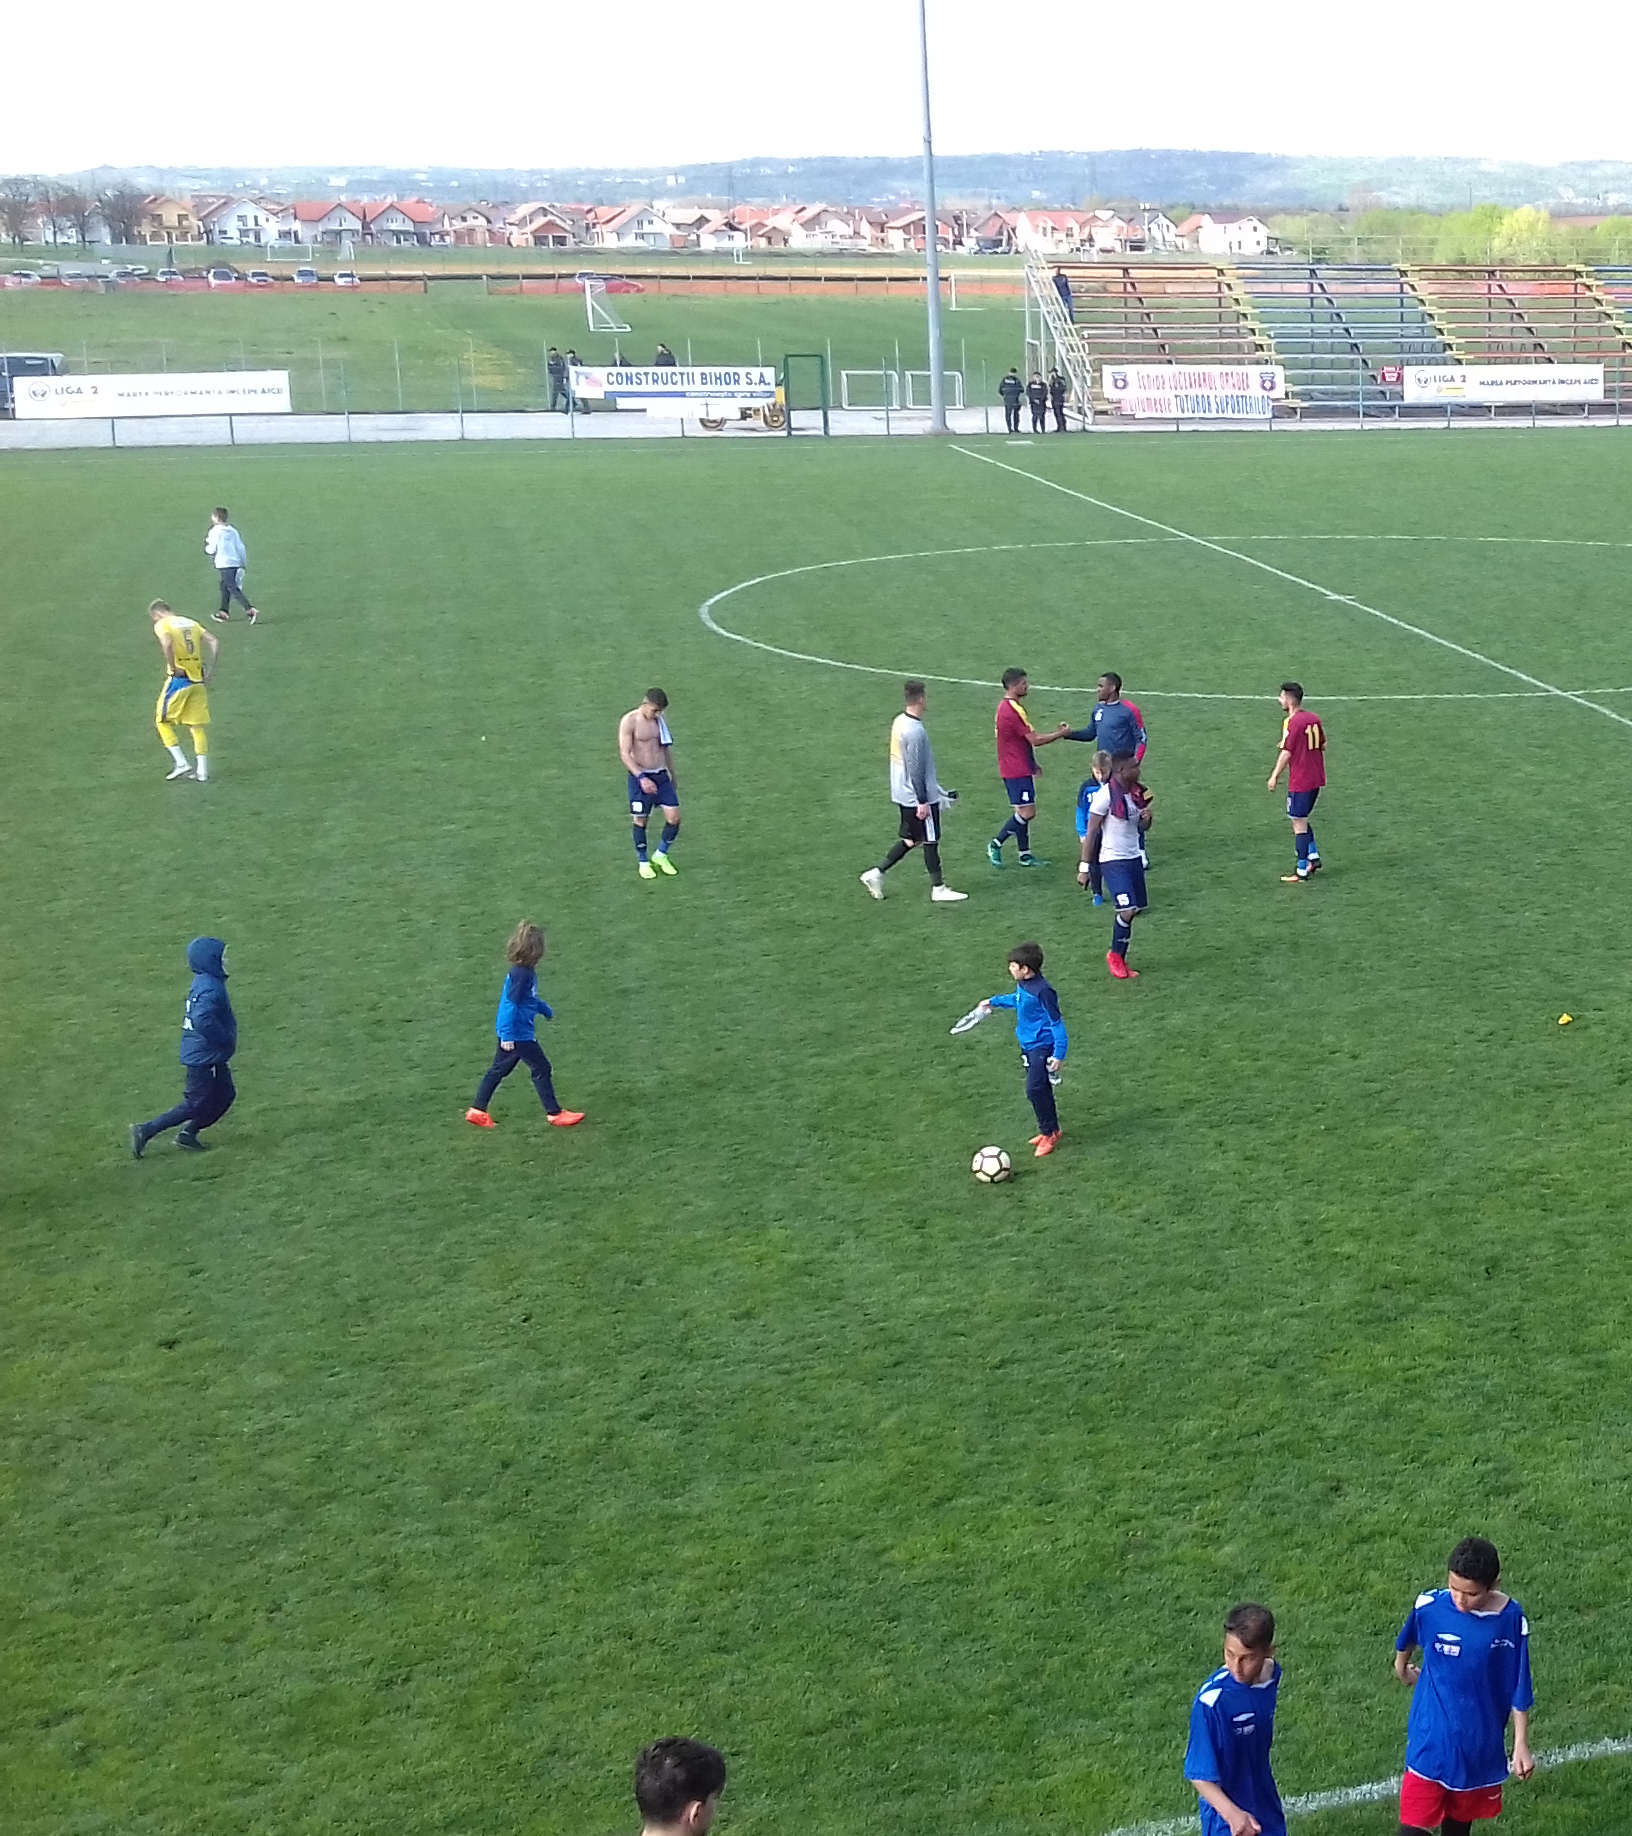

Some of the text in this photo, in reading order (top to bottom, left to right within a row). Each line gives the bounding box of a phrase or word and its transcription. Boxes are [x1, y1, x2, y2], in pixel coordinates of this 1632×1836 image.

[700, 371, 741, 386] BIHOR
[745, 371, 771, 386] S.A.
[1433, 374, 1467, 383] LIGA 2
[55, 386, 99, 395] LIGA 2
[1304, 723, 1320, 750] 11
